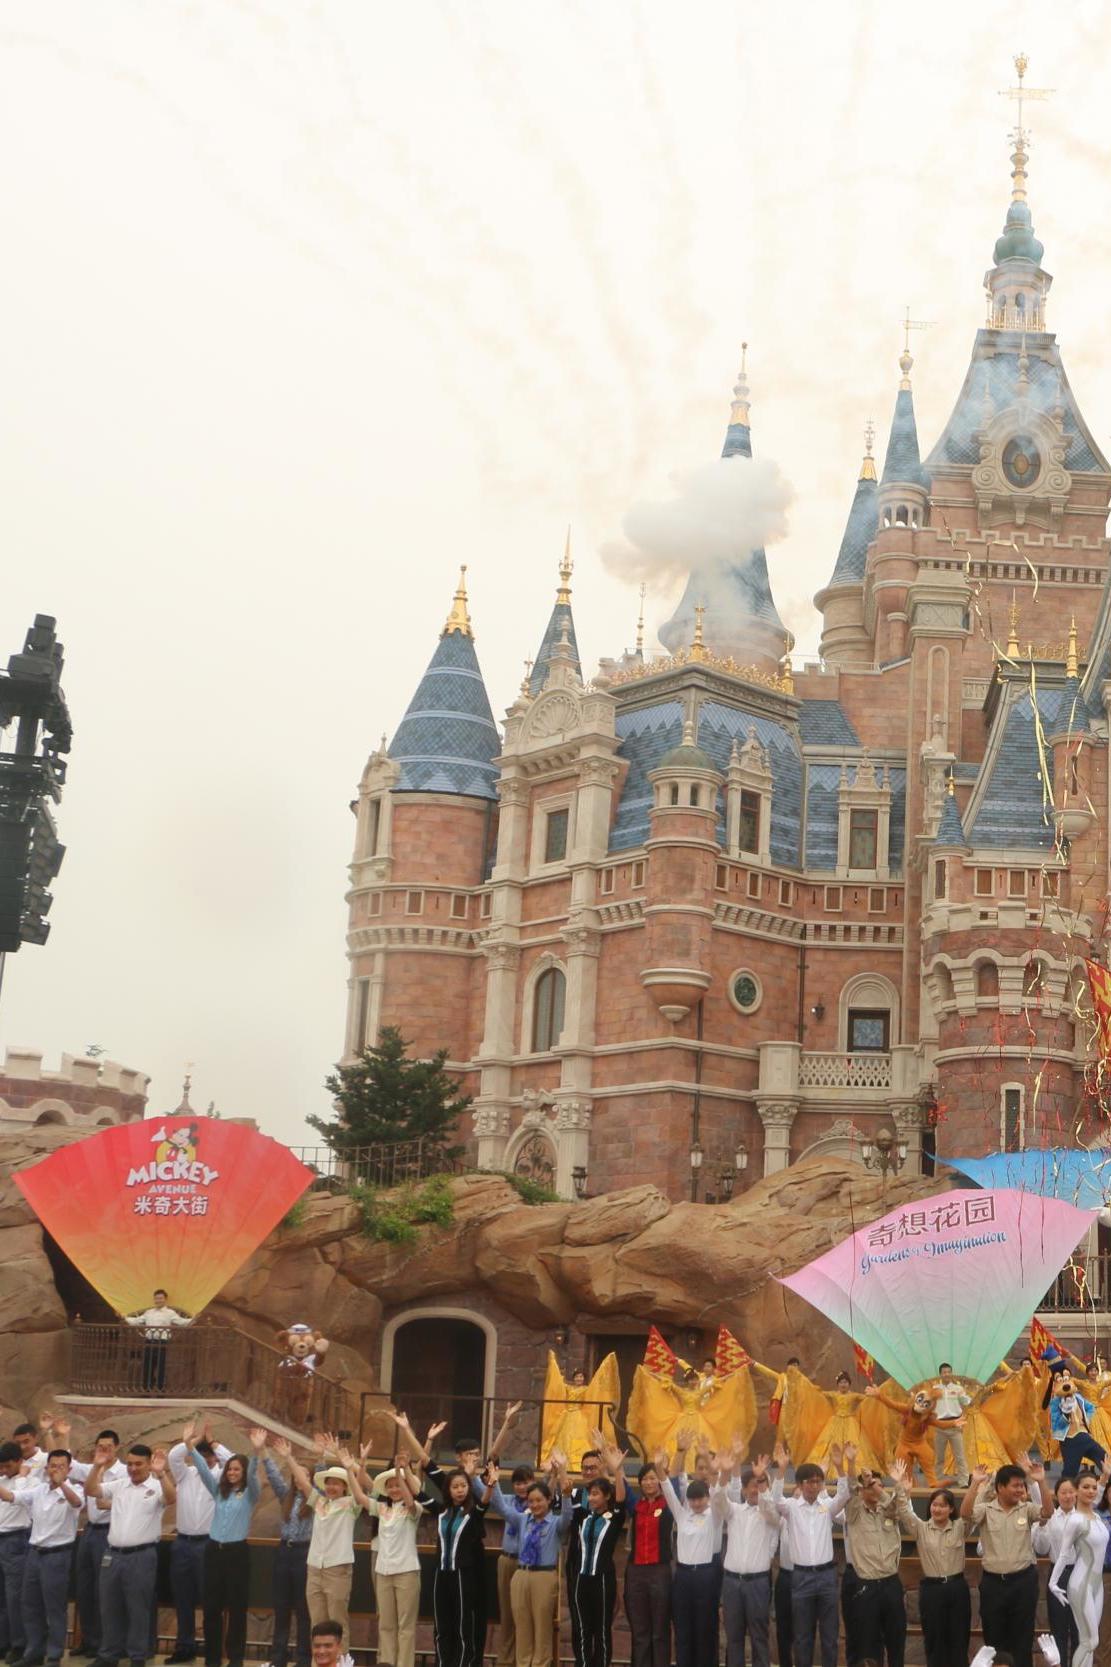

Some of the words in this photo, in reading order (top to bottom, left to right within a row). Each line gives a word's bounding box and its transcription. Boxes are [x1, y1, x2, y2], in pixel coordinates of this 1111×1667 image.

[125, 1160, 219, 1188] MICKEY
[148, 1184, 197, 1194] AVENUE
[133, 1195, 209, 1216] 米奇大街
[867, 1196, 995, 1247] 奇想花园
[861, 1247, 910, 1275] Gardens
[923, 1231, 1007, 1258] Imagination
